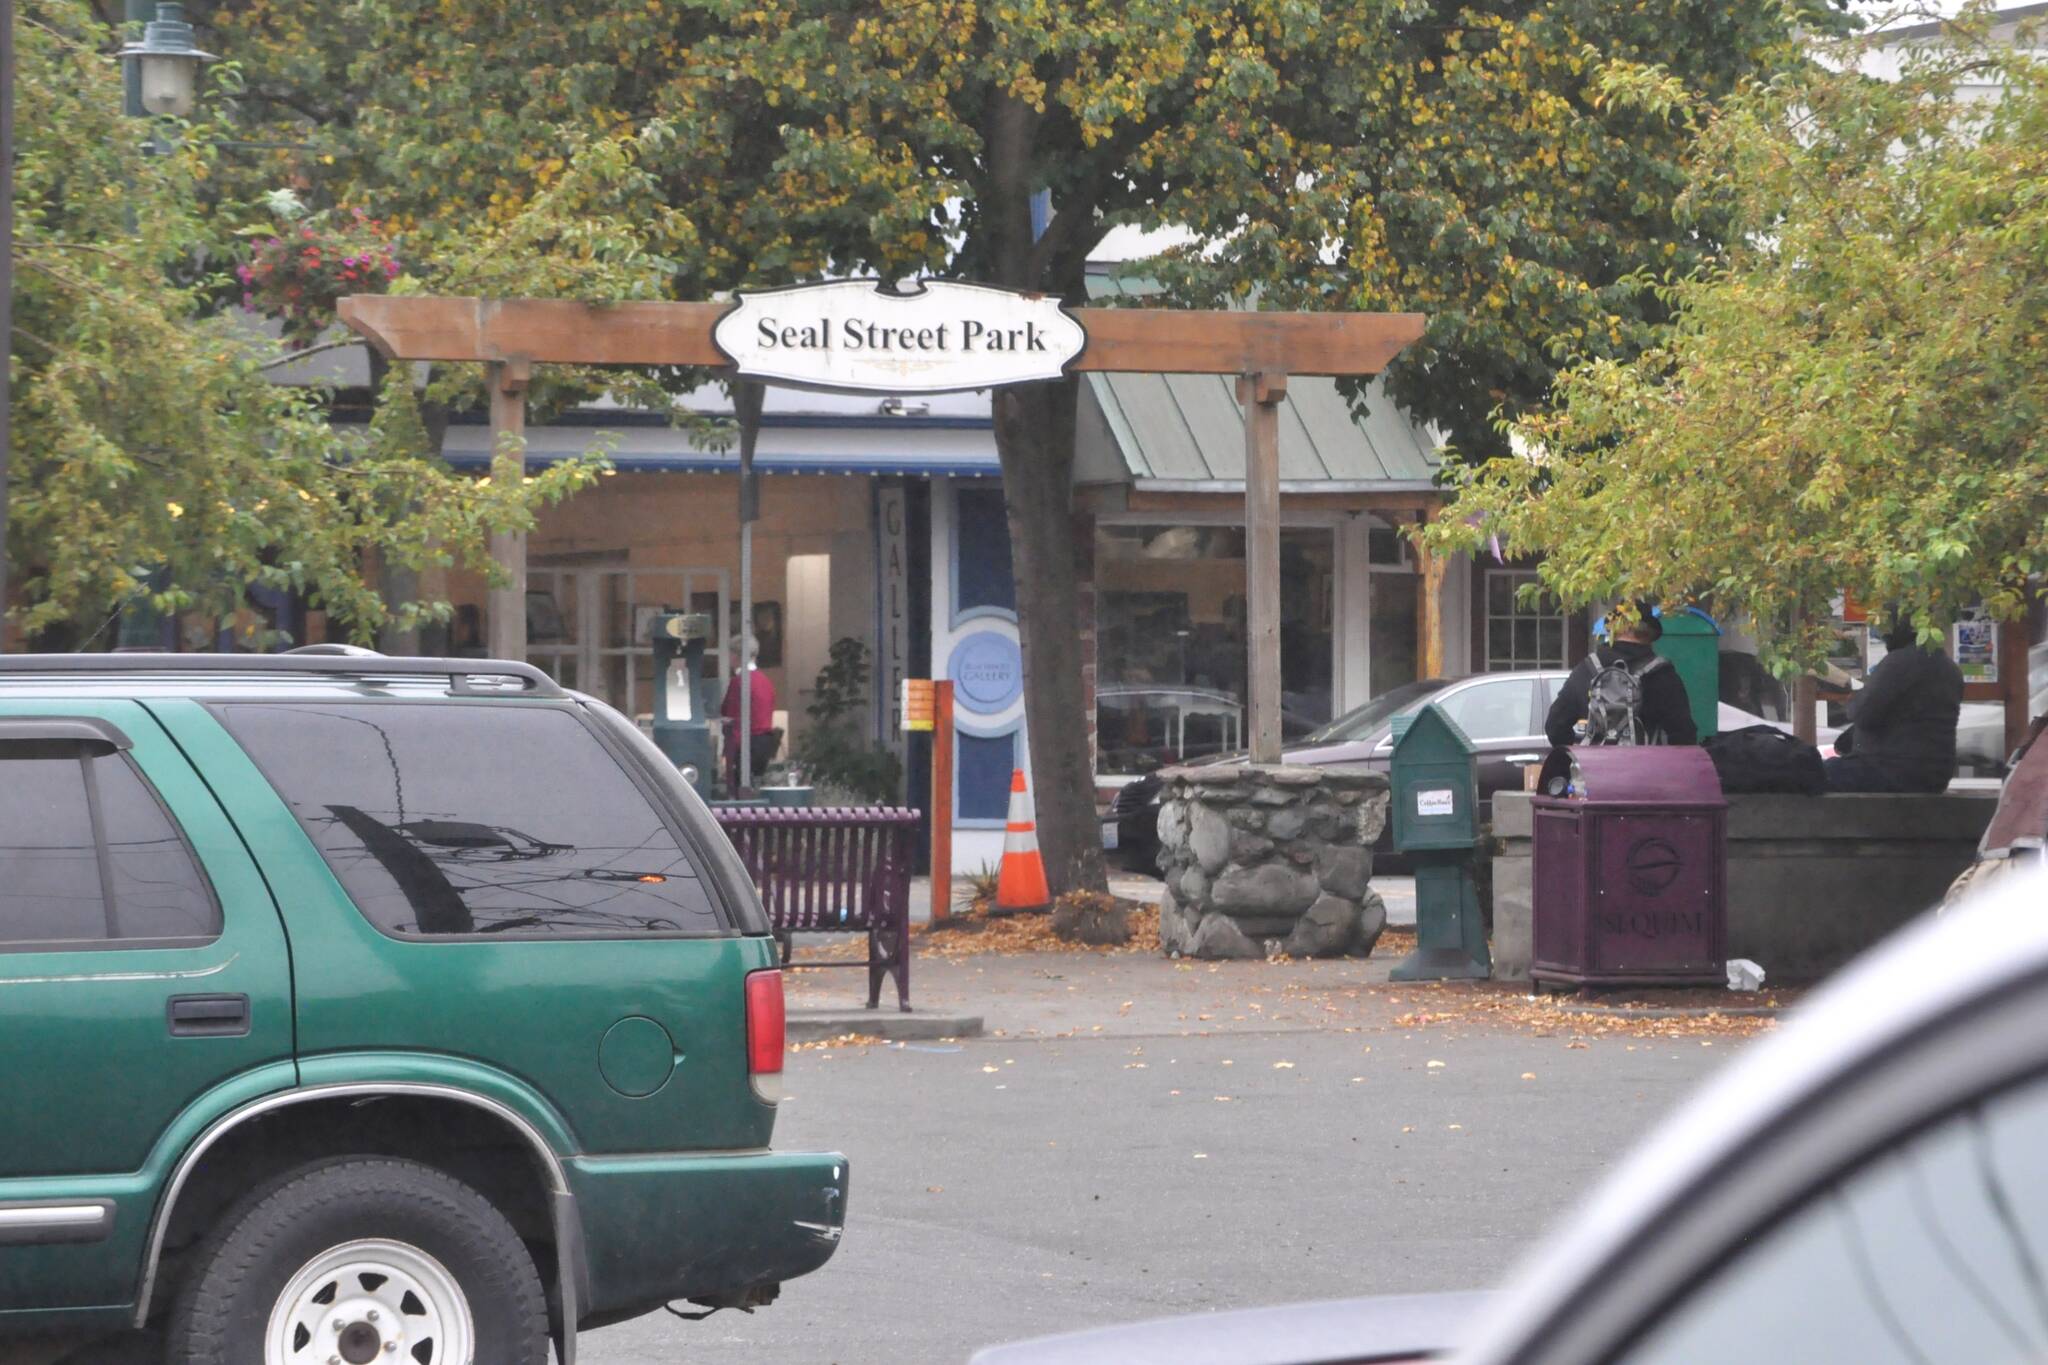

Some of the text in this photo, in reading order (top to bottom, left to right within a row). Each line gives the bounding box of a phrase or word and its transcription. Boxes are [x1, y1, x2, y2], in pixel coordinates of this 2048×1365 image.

[757, 316, 1048, 352] Seal Street Park
[886, 501, 902, 743] GALLER
[1603, 911, 1704, 939] SEQUIM
